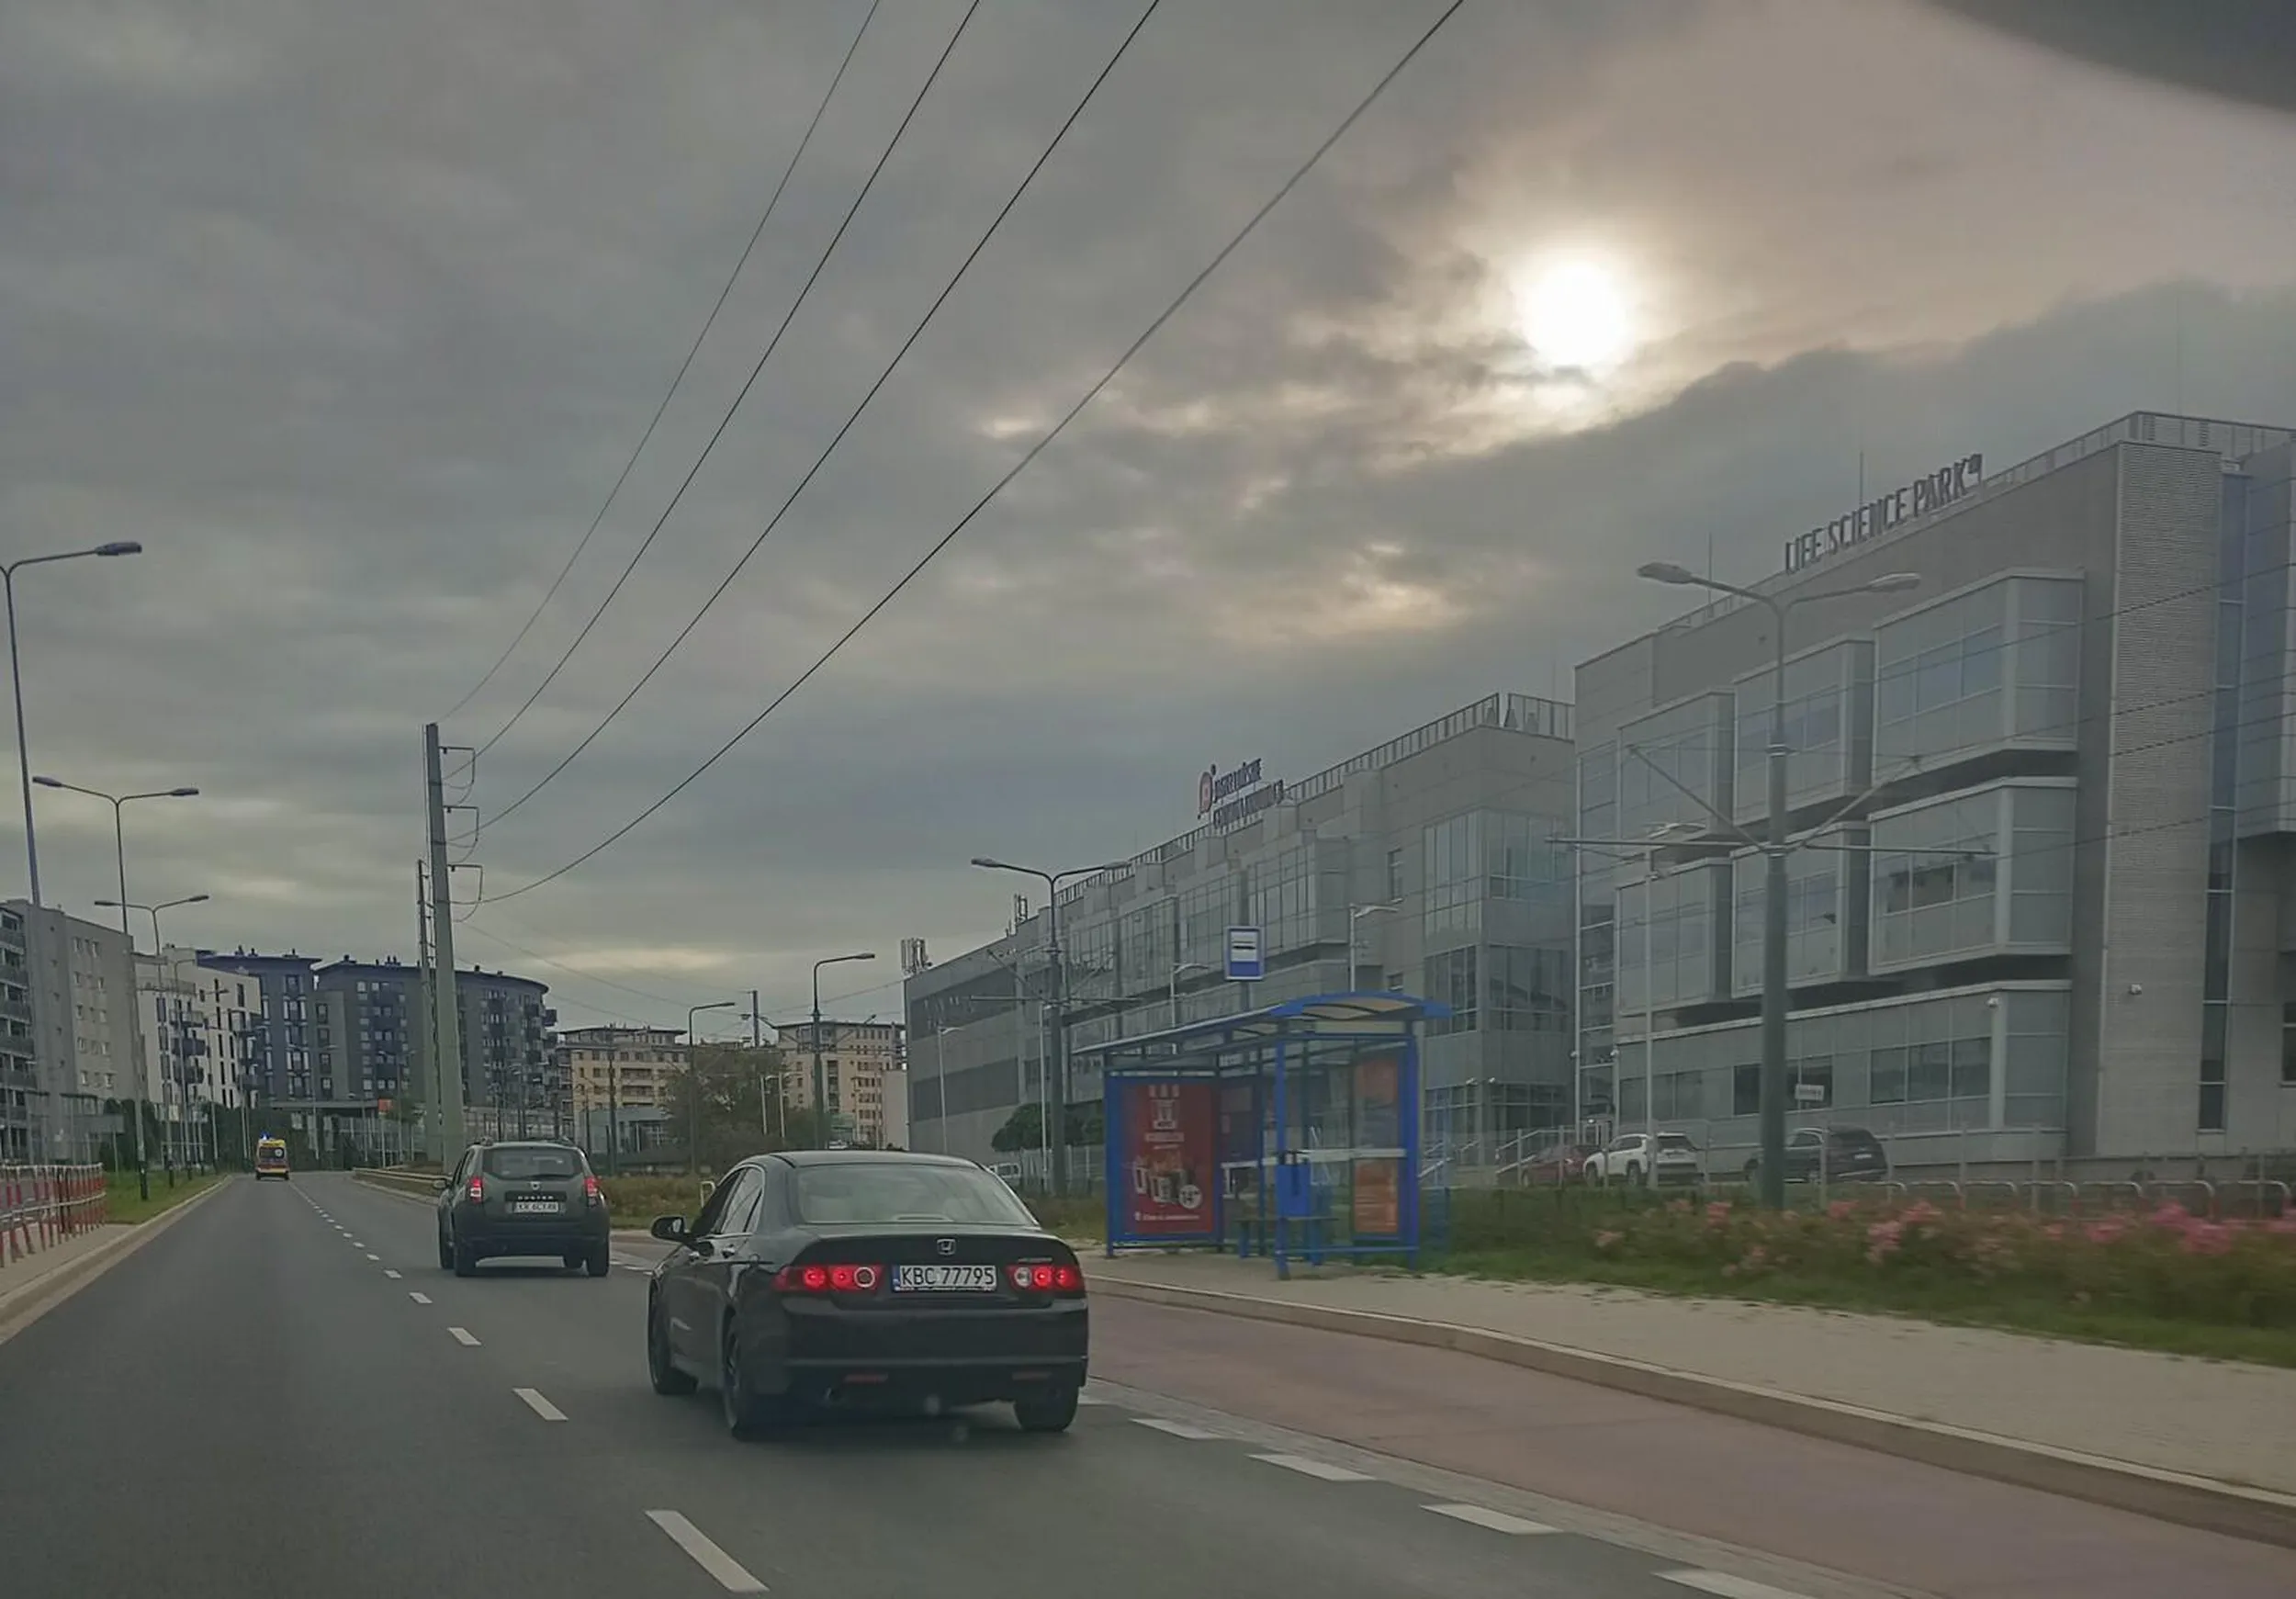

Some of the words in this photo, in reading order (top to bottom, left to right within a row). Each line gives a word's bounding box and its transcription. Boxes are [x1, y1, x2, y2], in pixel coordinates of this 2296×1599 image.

[1785, 528, 1824, 574] LIFE
[1828, 488, 1908, 555] SCIENCE
[1913, 458, 1967, 517] PARK
[901, 1267, 936, 1285] KBC
[940, 1267, 995, 1285] 77795
